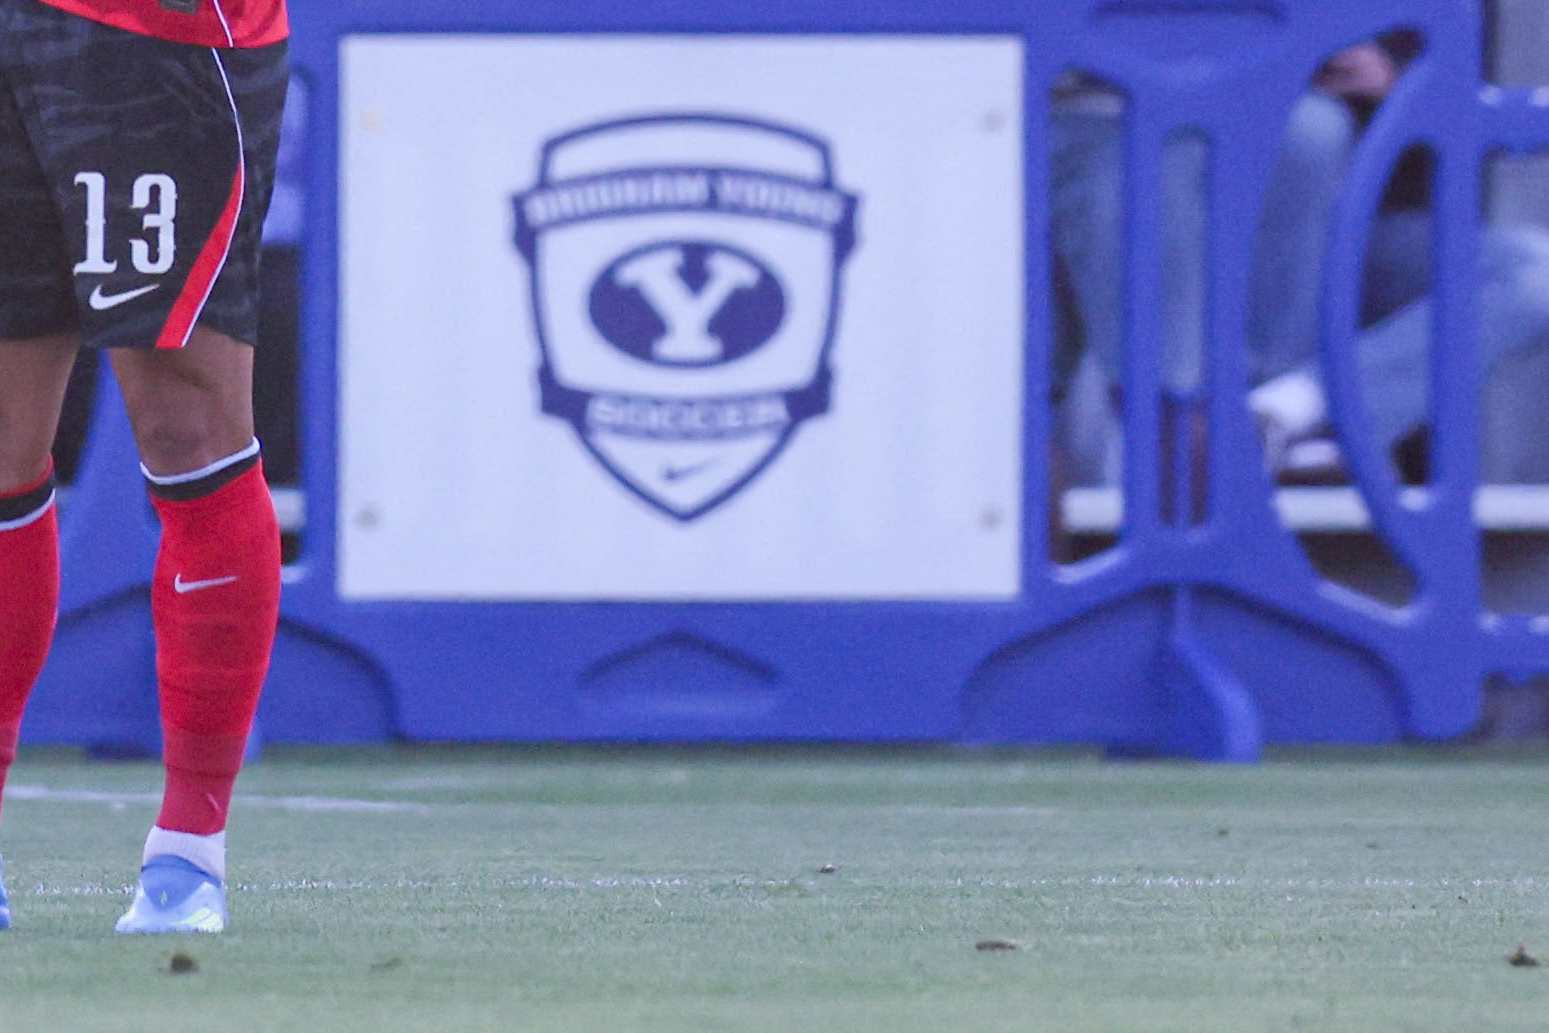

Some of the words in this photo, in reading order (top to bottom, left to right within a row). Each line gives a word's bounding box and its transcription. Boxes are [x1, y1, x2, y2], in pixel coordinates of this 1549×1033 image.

[72, 171, 178, 277] 13
[614, 246, 762, 361] Y
[590, 396, 790, 432] SOCCER
